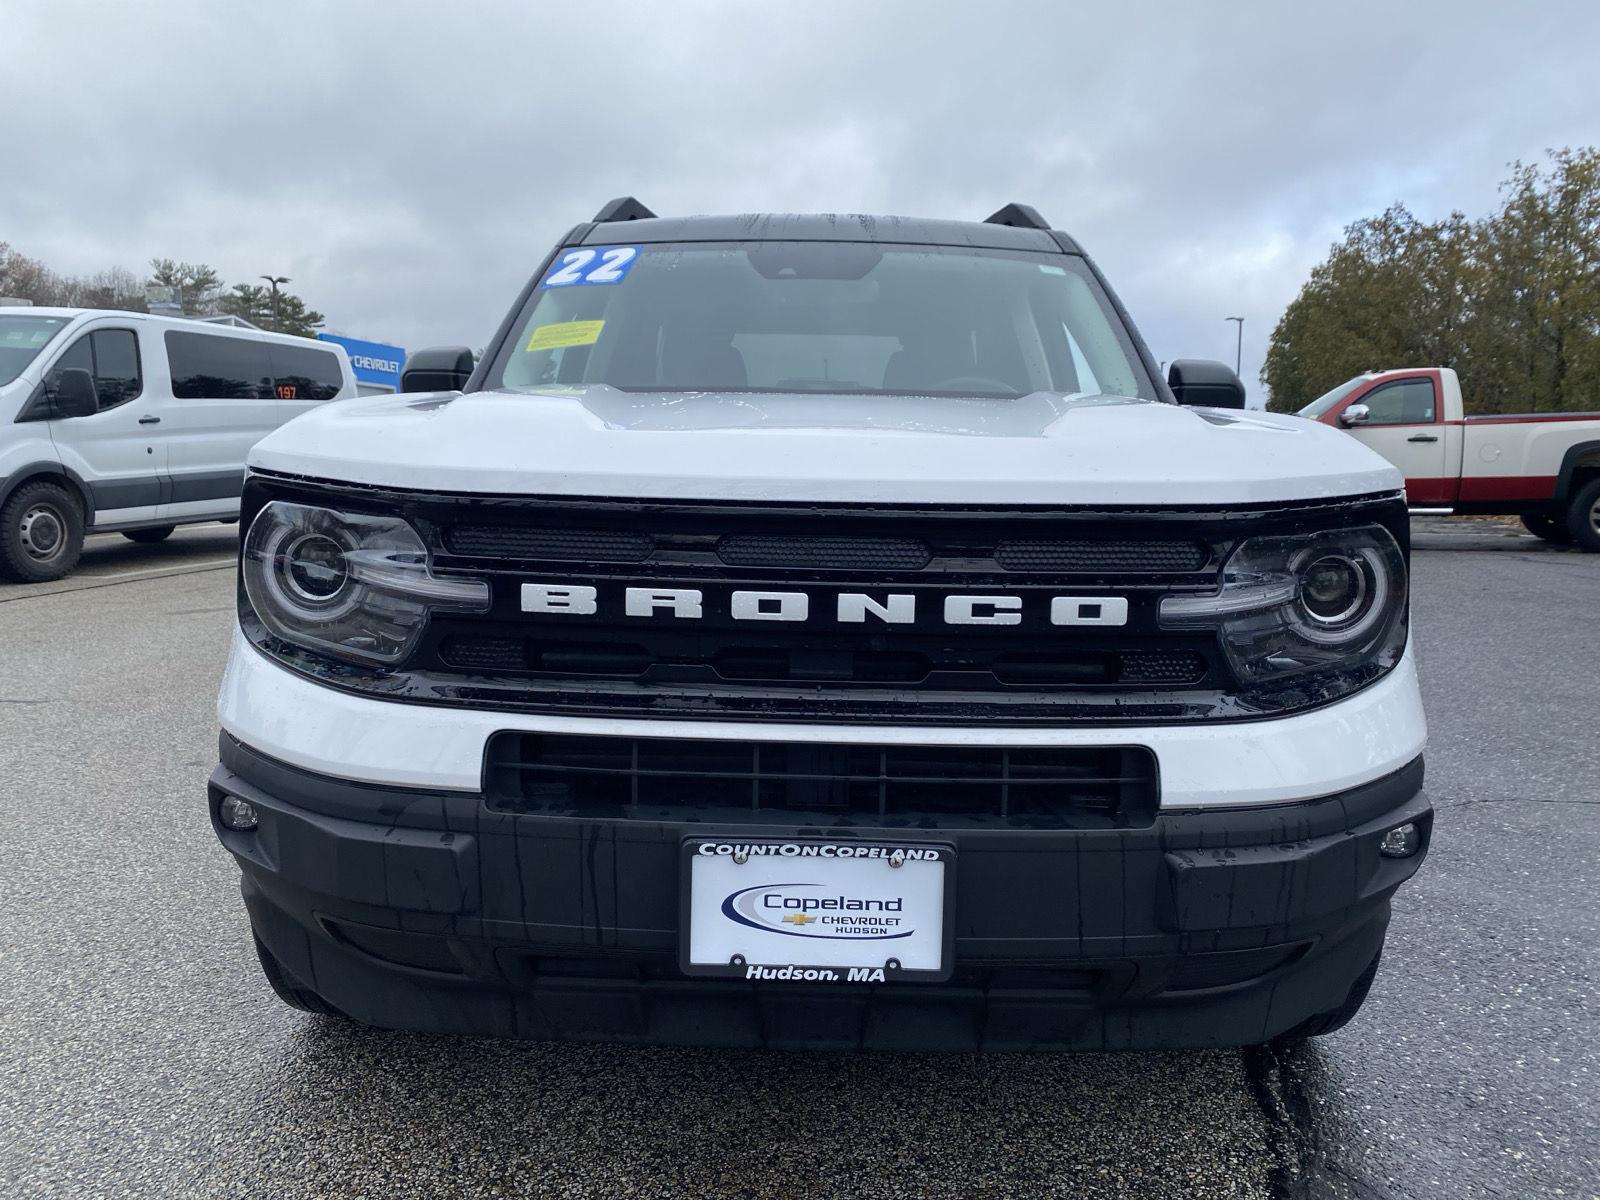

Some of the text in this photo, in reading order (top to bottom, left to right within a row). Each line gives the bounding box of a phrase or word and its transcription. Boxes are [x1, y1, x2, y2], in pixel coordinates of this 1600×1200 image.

[546, 247, 636, 285] 22
[354, 355, 399, 373] CHEVROLET
[278, 386, 296, 399] 197
[521, 582, 1128, 626] BRONCO
[763, 894, 903, 912] Copeland
[822, 916, 902, 926] CHEVROLET
[835, 926, 888, 935] HUDSON
[745, 965, 886, 983] Hudson, MA
